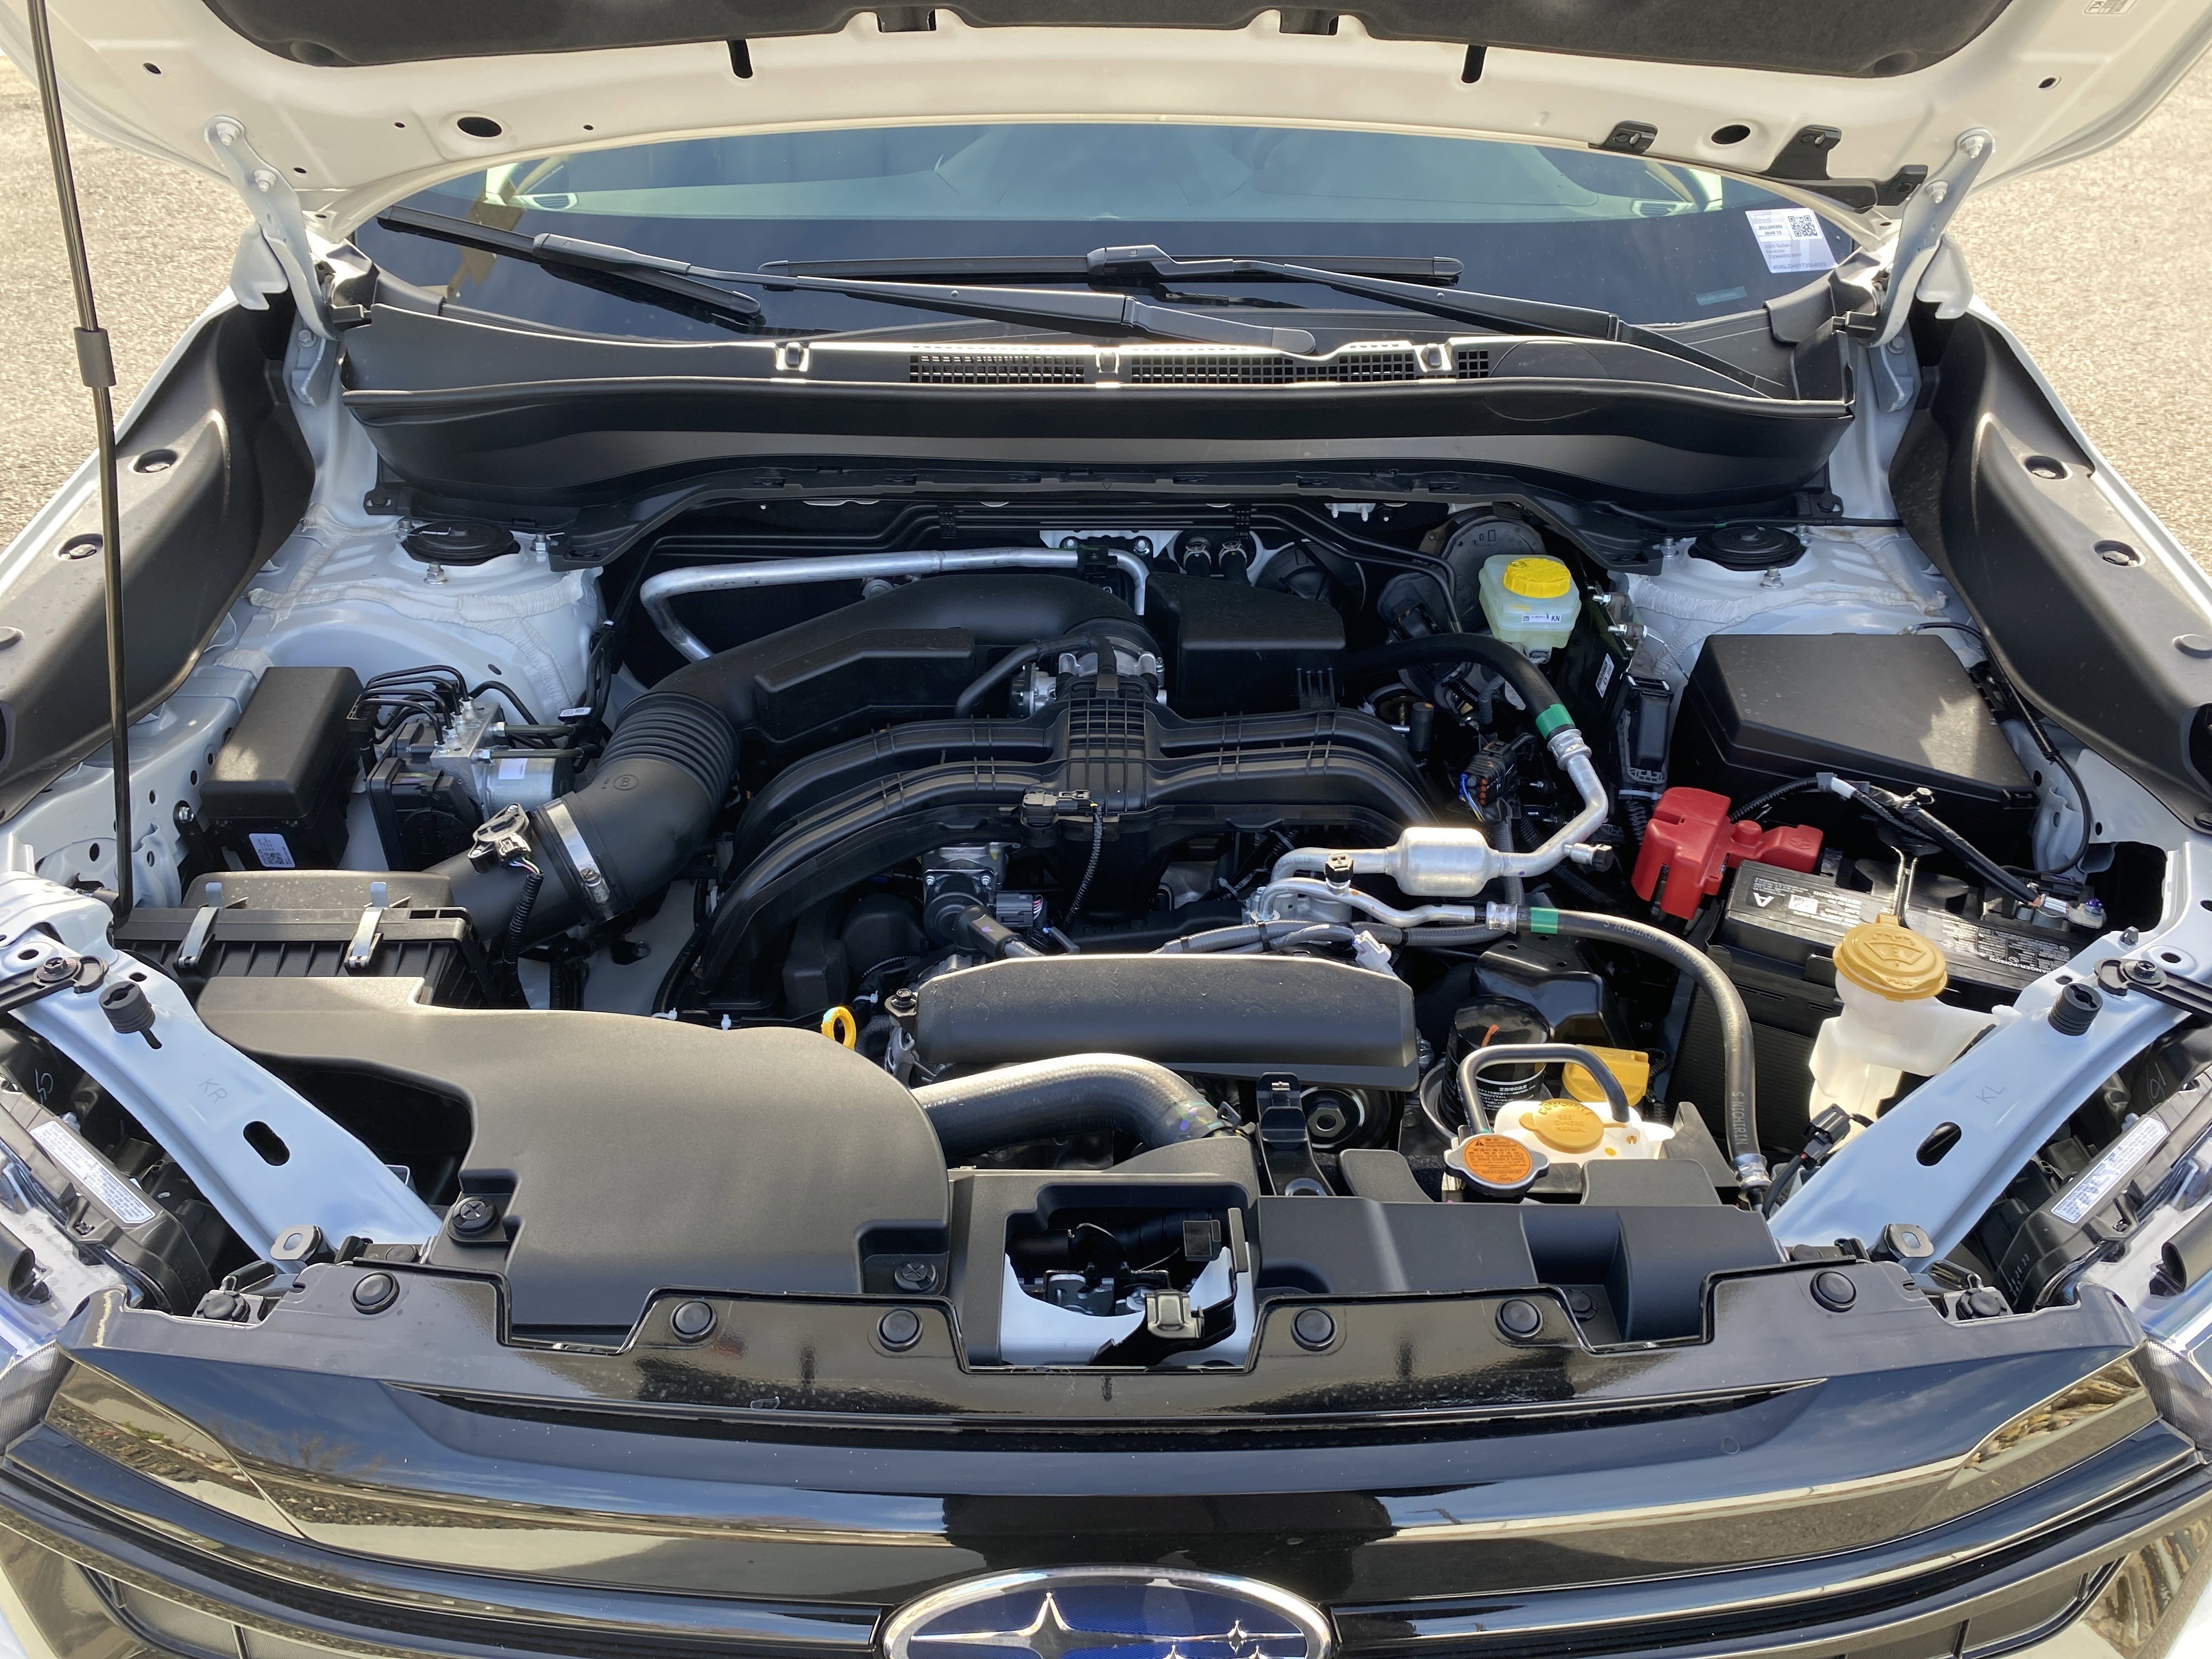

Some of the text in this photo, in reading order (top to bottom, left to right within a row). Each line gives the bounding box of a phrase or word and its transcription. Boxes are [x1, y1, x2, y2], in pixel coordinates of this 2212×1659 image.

[1887, 978, 1913, 986] PULL
[198, 1077, 228, 1104] KR
[1975, 1085, 2006, 1105] KL
[1538, 1102, 1594, 1115] COOLANT
